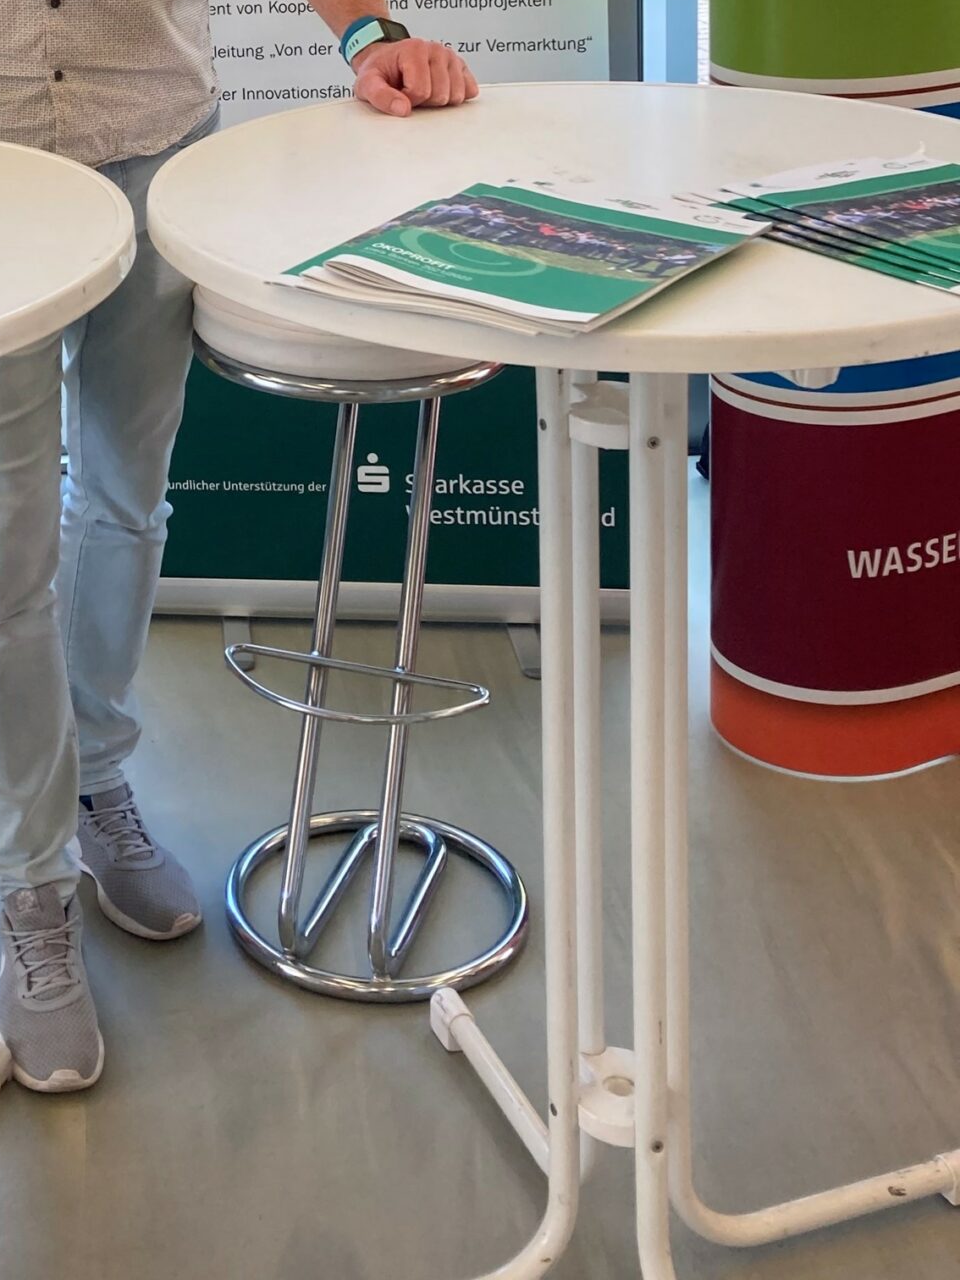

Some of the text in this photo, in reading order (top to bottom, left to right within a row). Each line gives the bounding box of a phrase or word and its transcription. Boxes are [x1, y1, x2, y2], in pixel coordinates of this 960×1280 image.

[236, 3, 263, 15] von
[212, 45, 265, 61] leitung
[308, 43, 333, 57] der
[457, 39, 481, 54] zur
[486, 36, 594, 54] Vermarktung“
[223, 480, 305, 494] Unterstützung
[307, 480, 327, 492] der
[847, 531, 960, 579] WASSE
